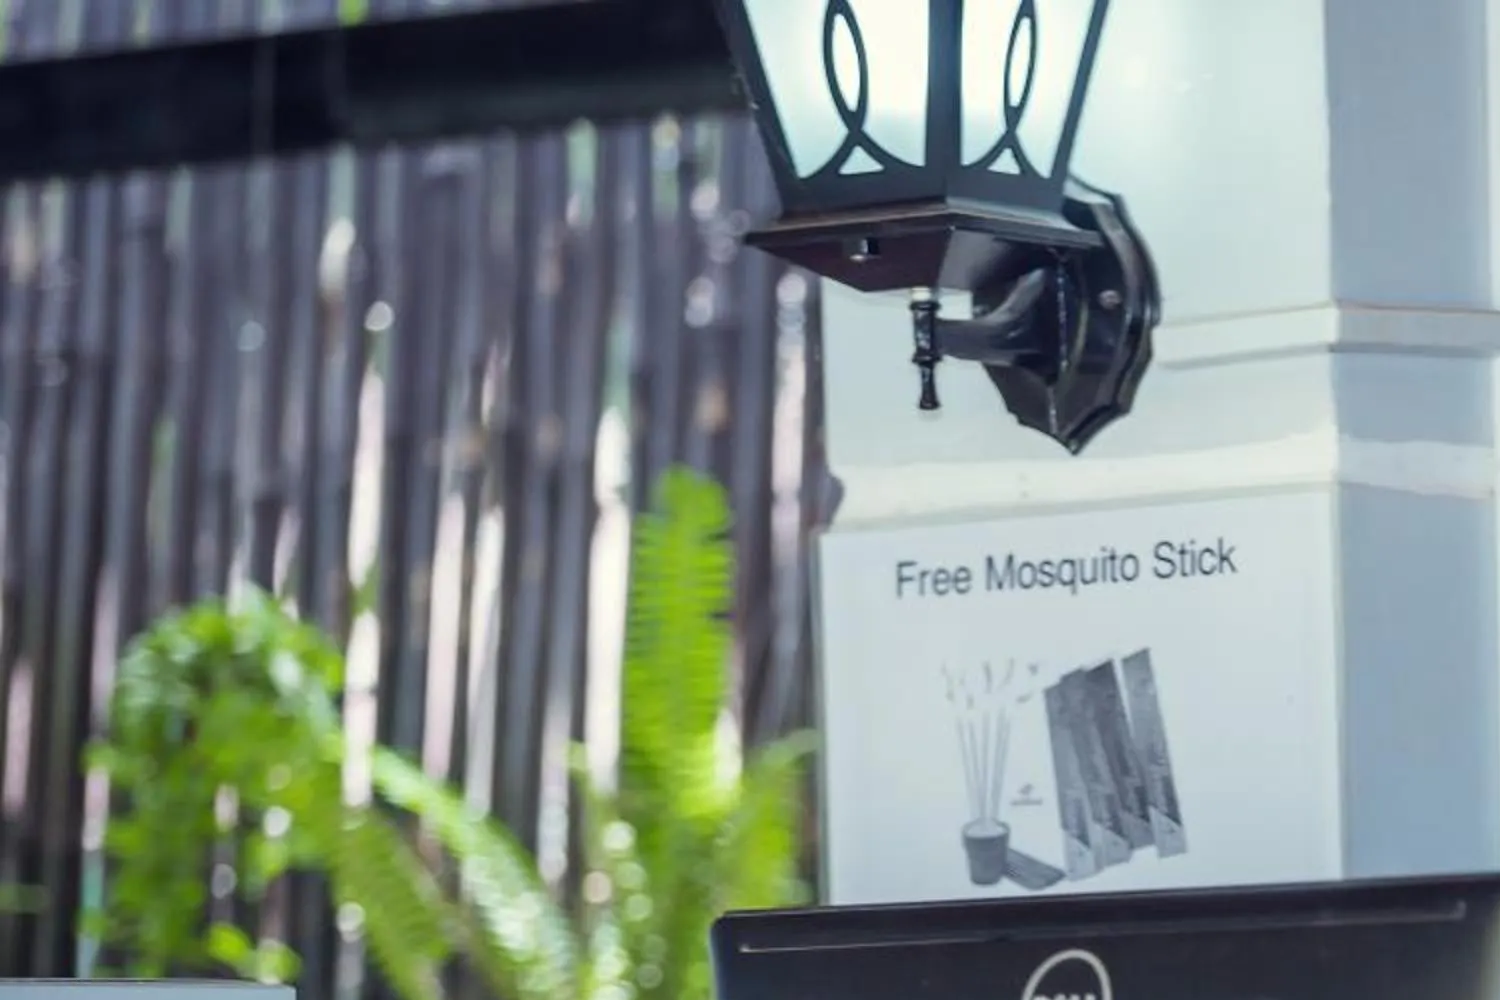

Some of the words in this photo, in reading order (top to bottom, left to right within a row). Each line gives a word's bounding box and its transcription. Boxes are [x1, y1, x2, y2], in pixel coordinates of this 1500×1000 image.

[895, 559, 973, 598] Free
[984, 546, 1141, 596] Mosquito
[1152, 537, 1238, 580] Stick
